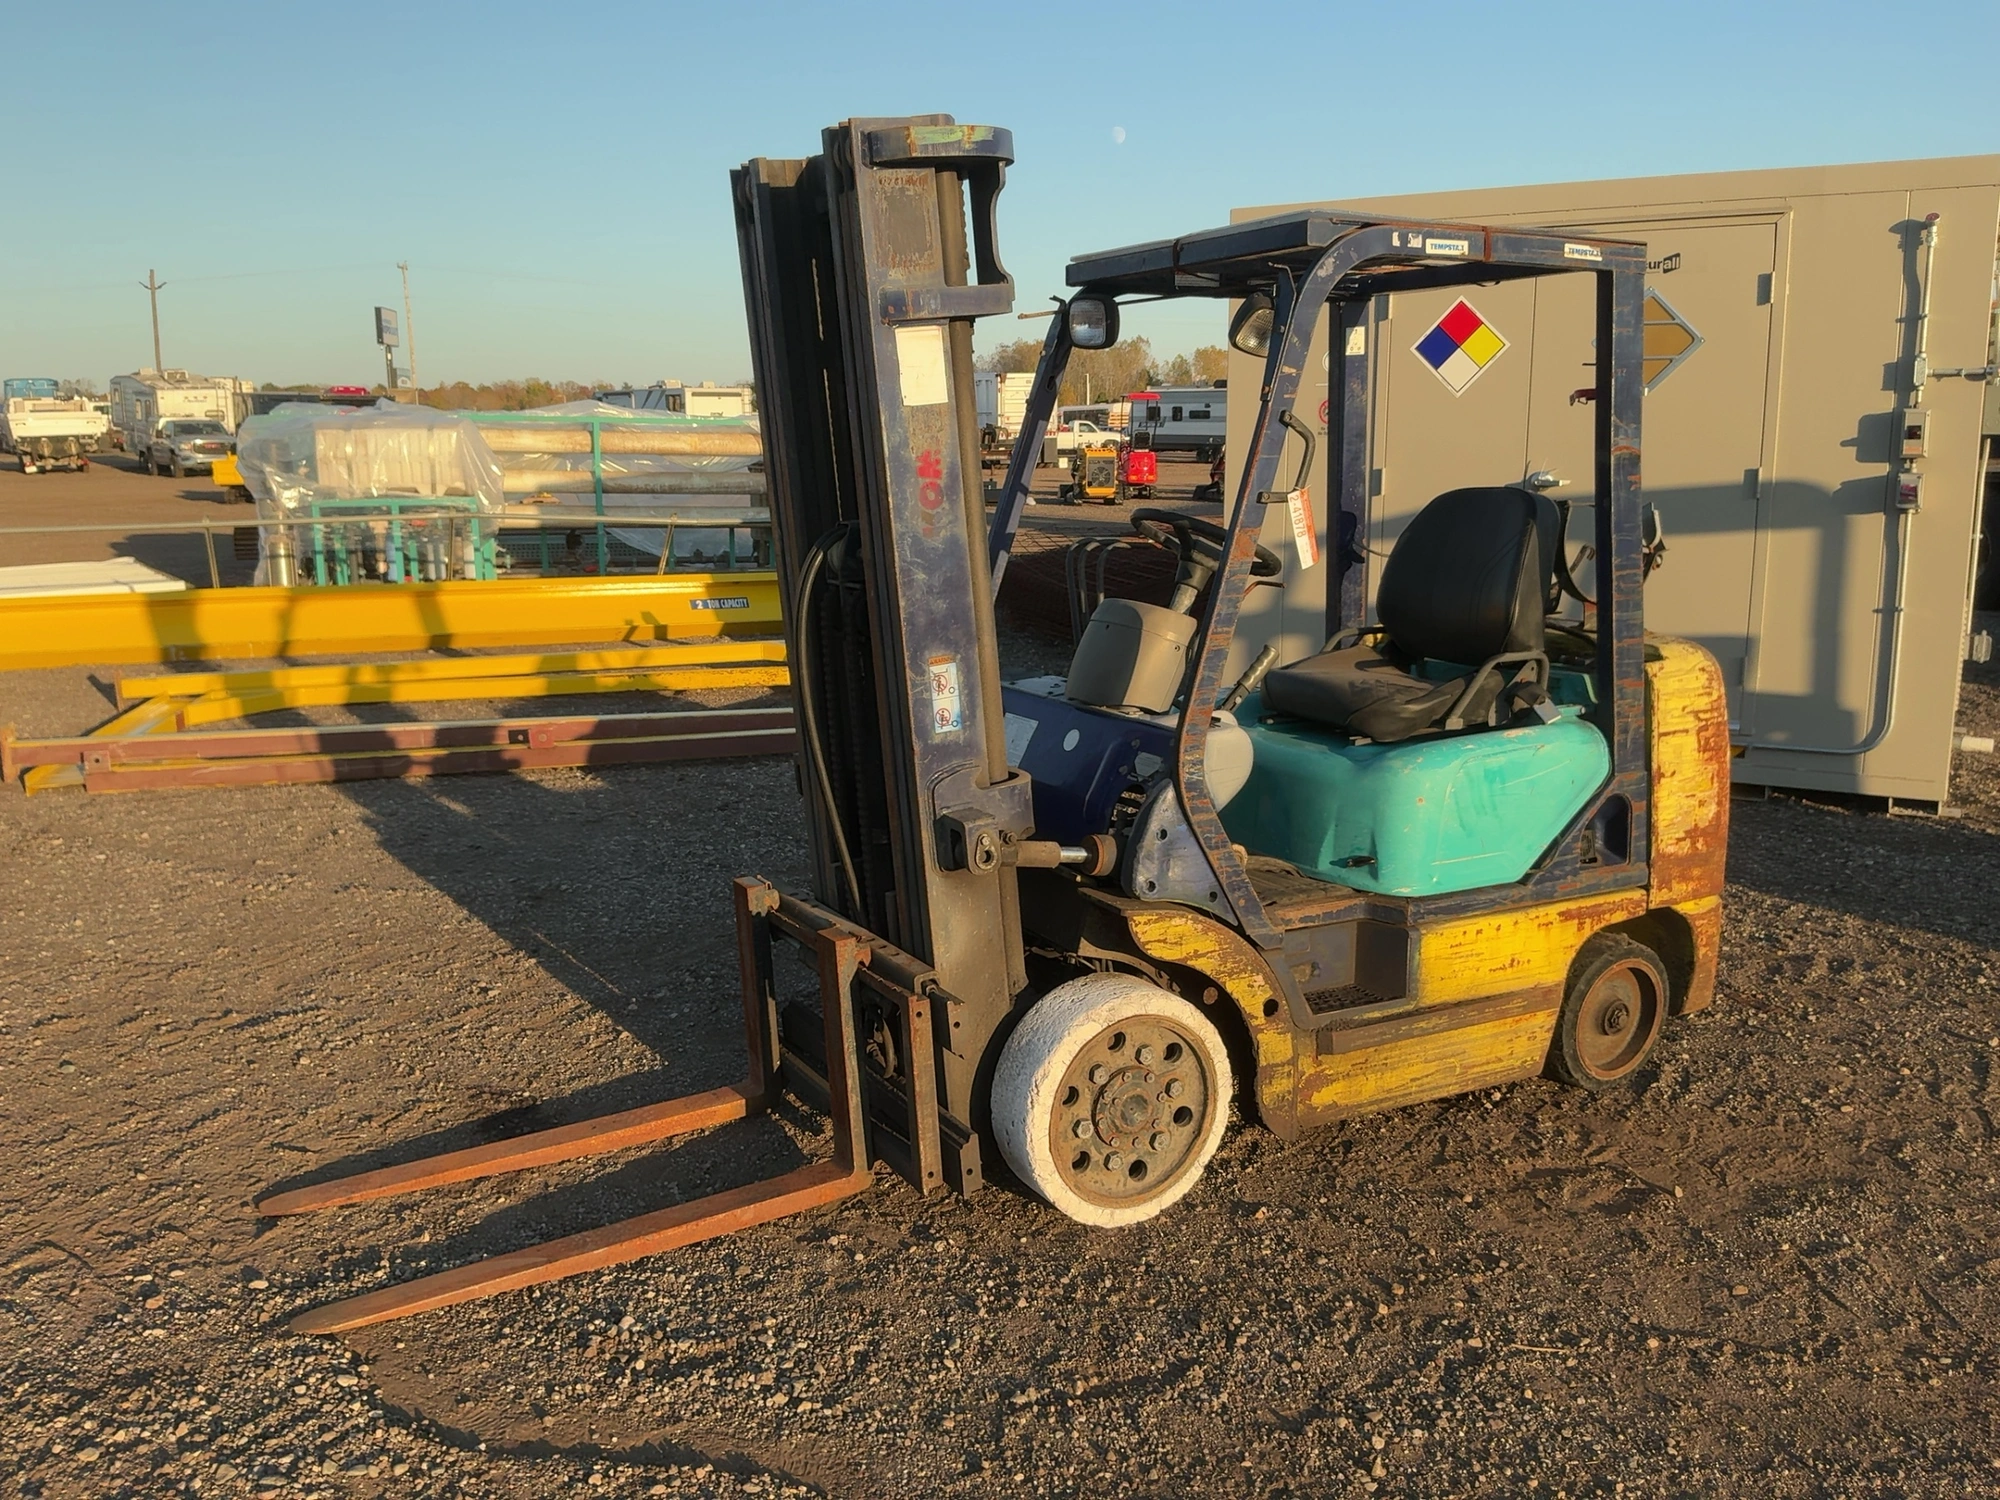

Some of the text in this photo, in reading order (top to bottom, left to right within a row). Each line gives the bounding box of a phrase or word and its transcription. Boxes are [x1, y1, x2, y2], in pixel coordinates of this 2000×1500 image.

[1645, 254, 1681, 271] urall
[695, 598, 748, 610] 2 TON CAPACITY
